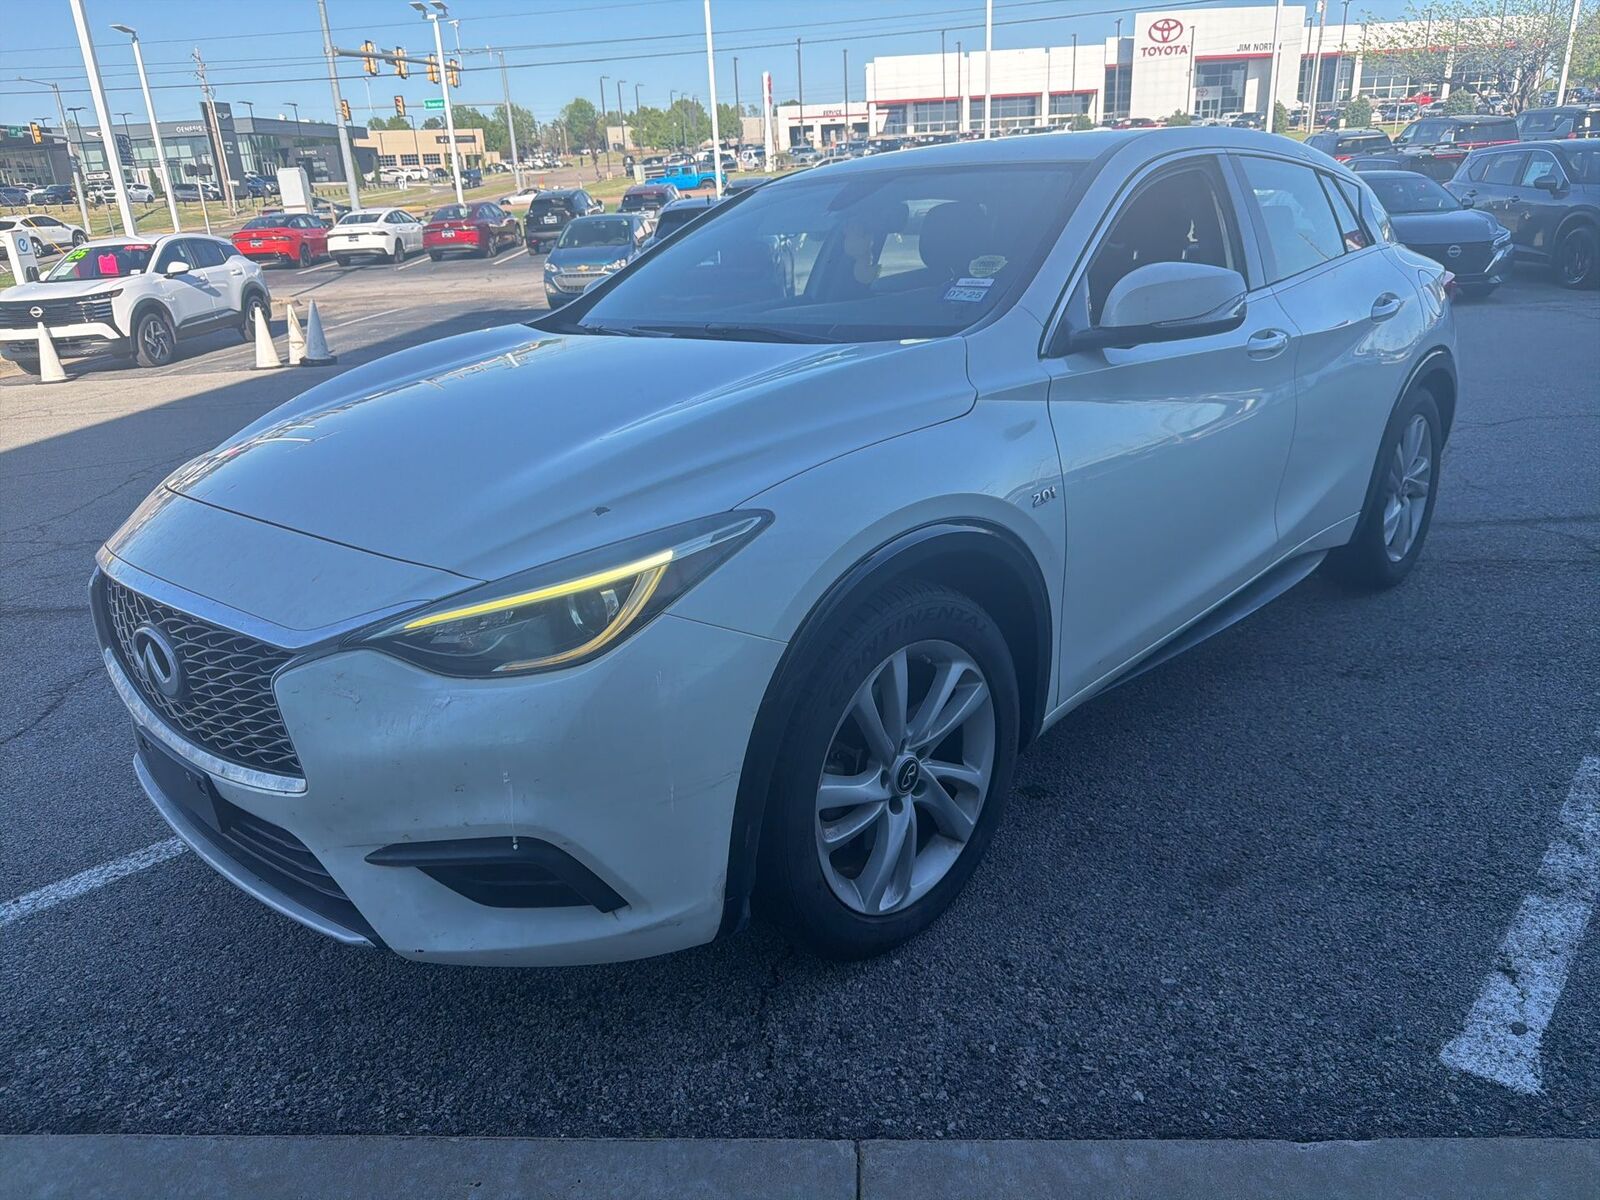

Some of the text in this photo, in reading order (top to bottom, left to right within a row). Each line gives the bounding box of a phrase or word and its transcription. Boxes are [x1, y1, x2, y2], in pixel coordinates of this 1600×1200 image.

[1141, 45, 1188, 57] TOYOTA
[1237, 42, 1282, 52] JIM NORT
[176, 125, 203, 133] GENESIS
